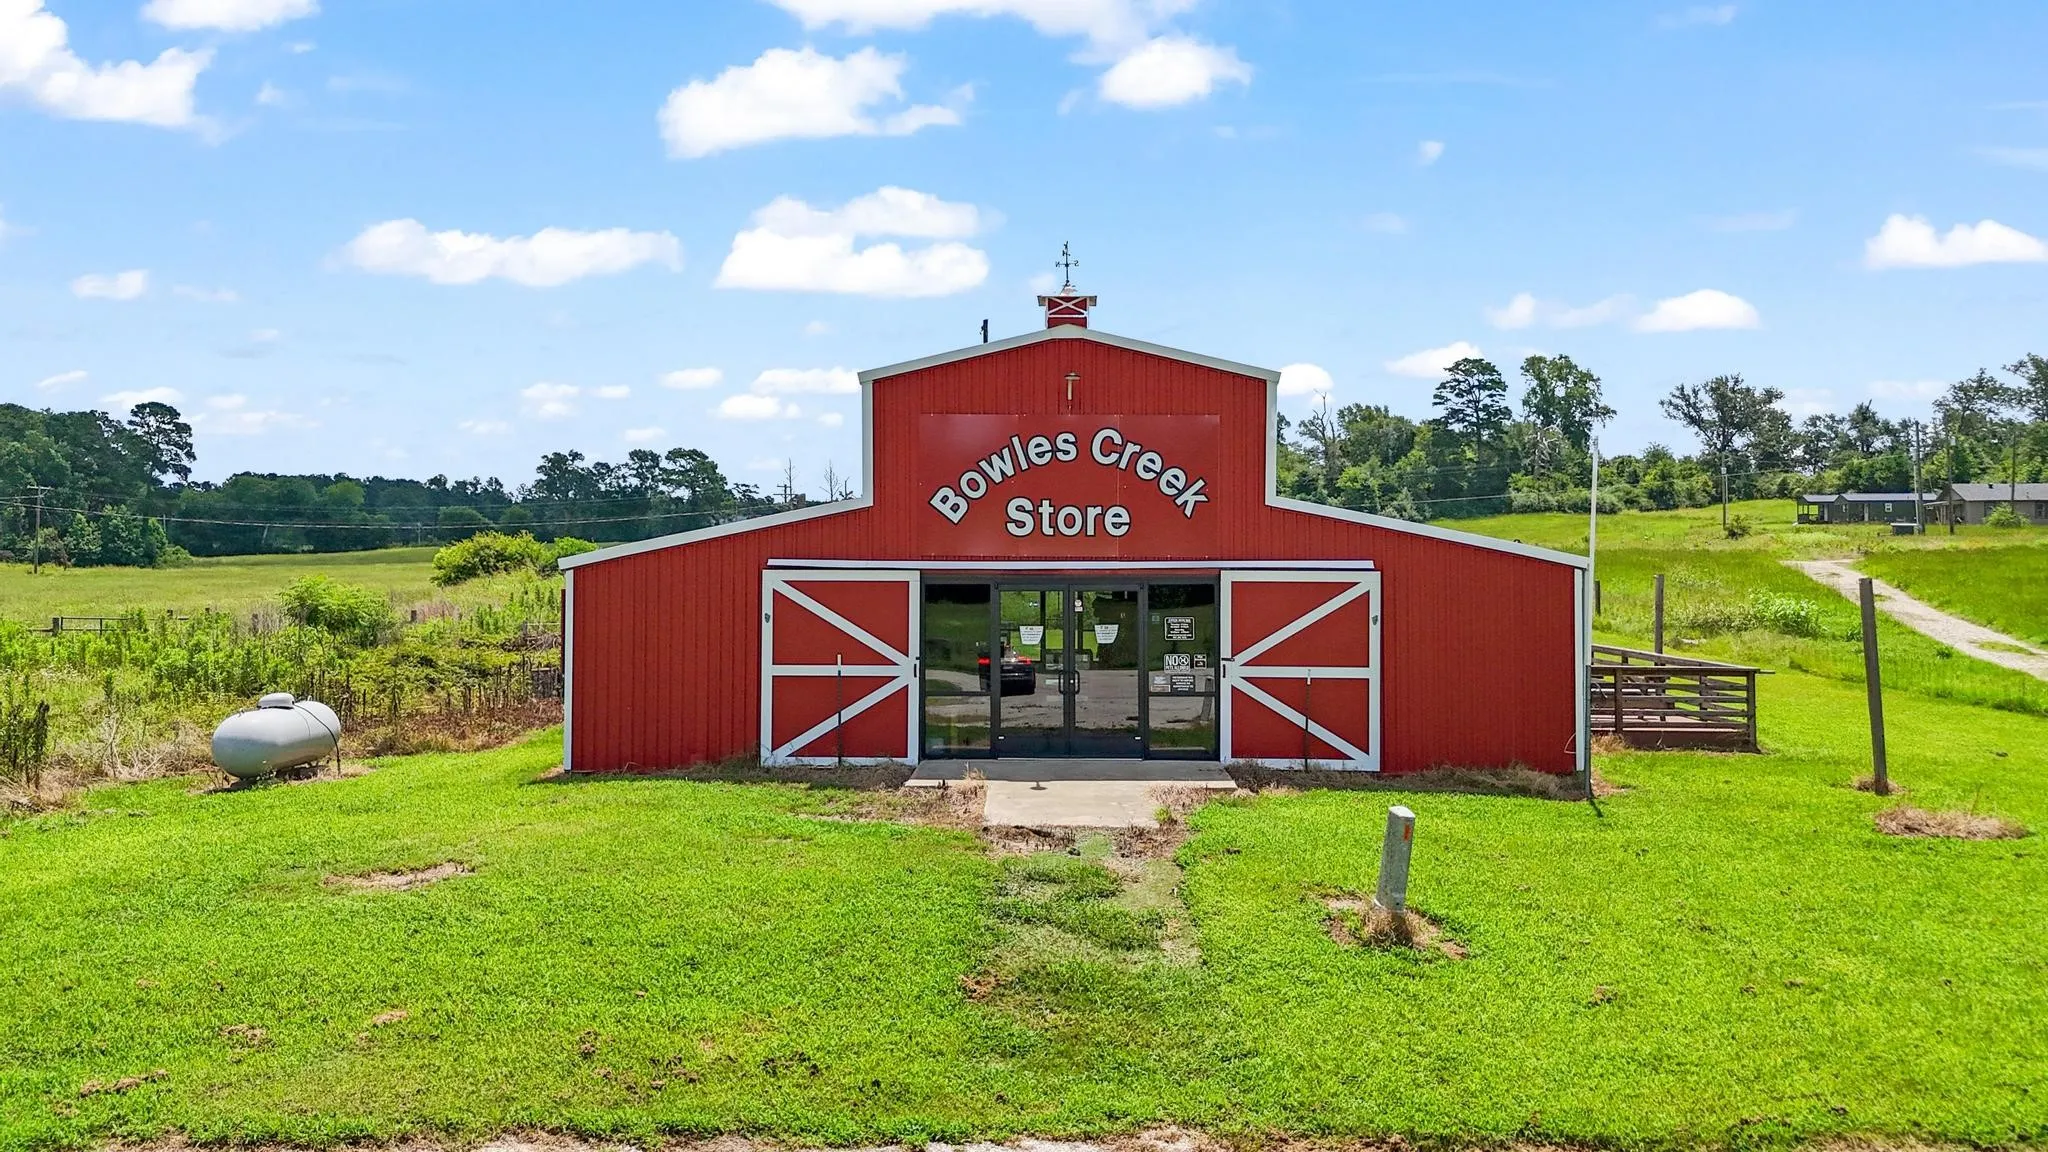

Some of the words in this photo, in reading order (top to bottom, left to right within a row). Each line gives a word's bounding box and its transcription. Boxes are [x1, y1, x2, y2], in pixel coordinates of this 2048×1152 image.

[928, 431, 1077, 524] Bowles
[1090, 427, 1209, 518] Creek
[1006, 496, 1131, 537] Store
[1165, 655, 1179, 666] NO
